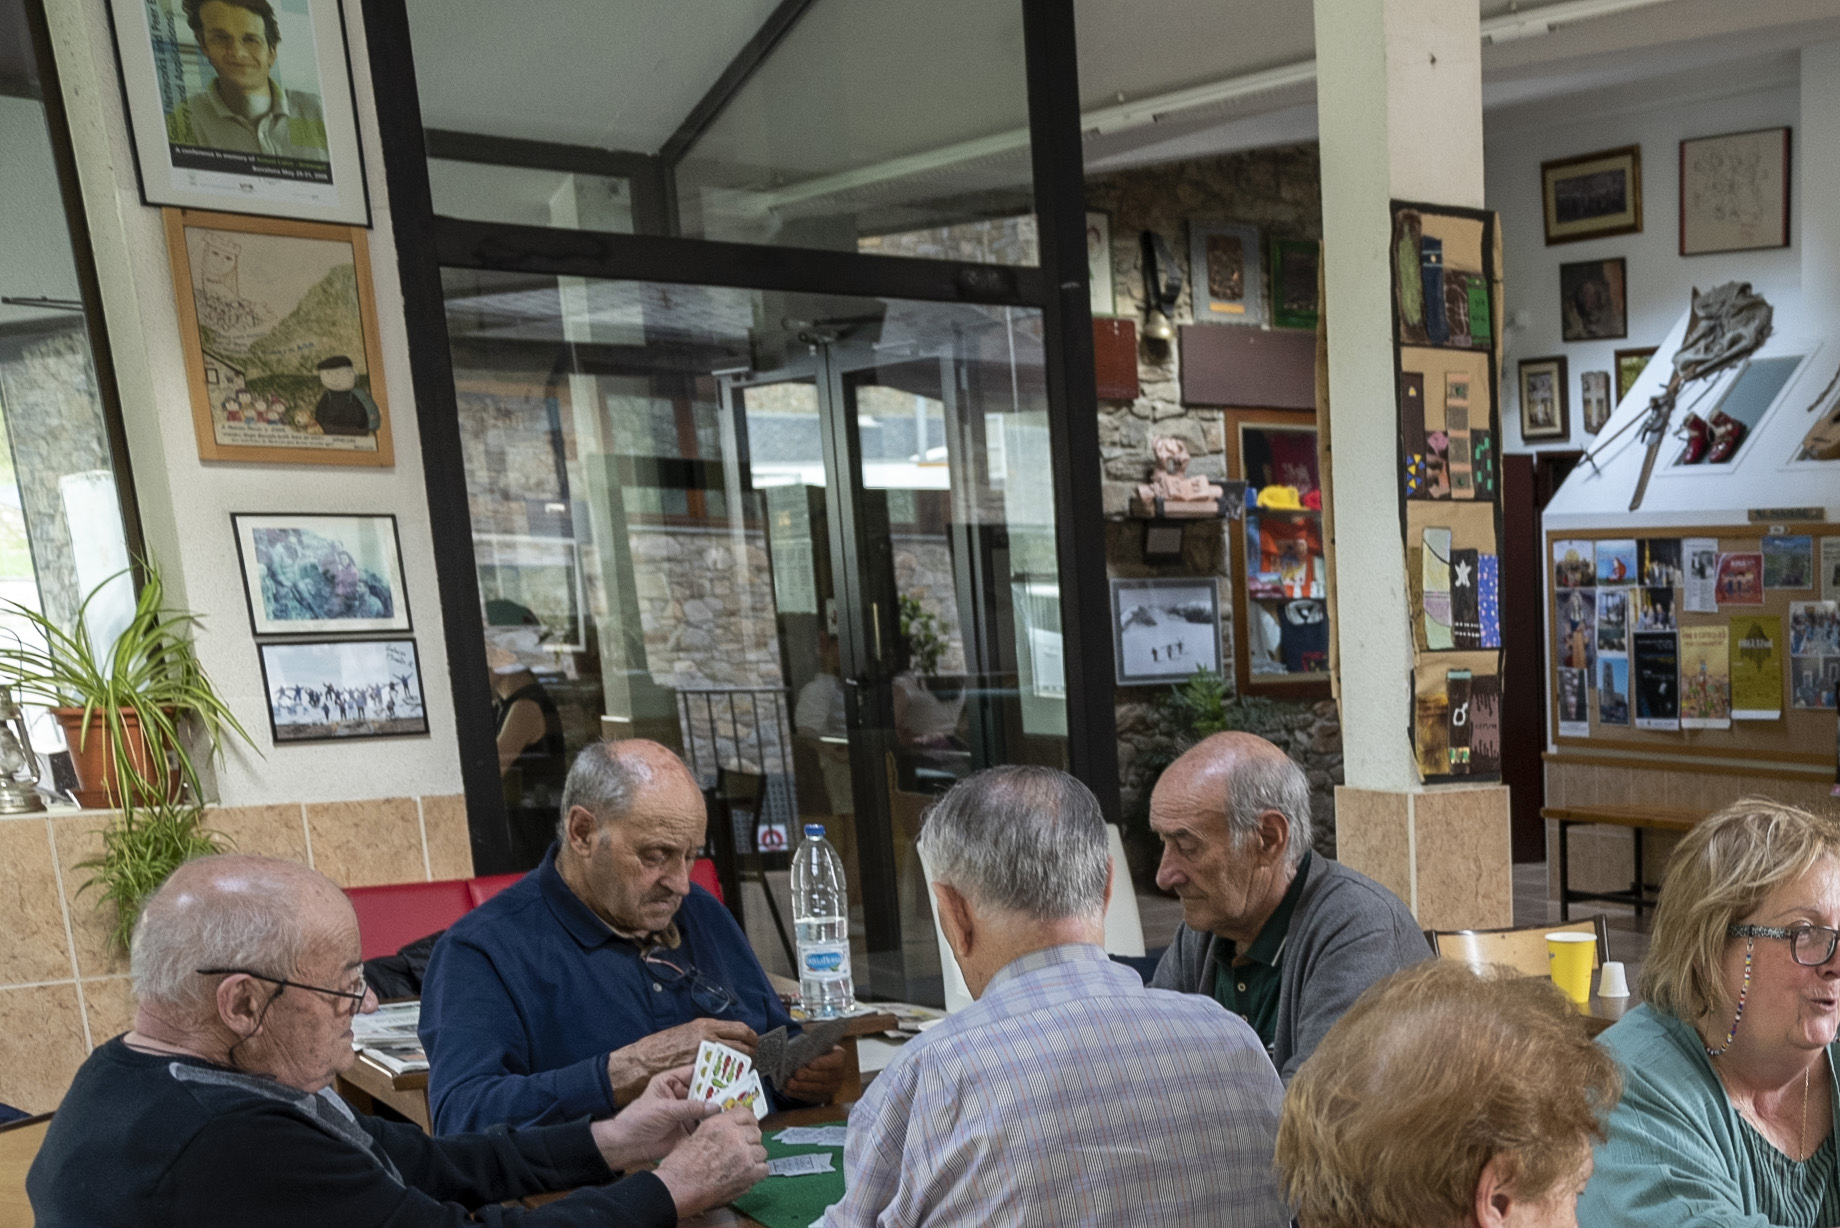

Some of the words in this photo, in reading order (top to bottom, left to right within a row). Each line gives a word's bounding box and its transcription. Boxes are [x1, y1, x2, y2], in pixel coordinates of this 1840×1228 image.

[181, 148, 215, 158] conference
[223, 154, 247, 163] memory
[252, 165, 281, 175] Barcelona
